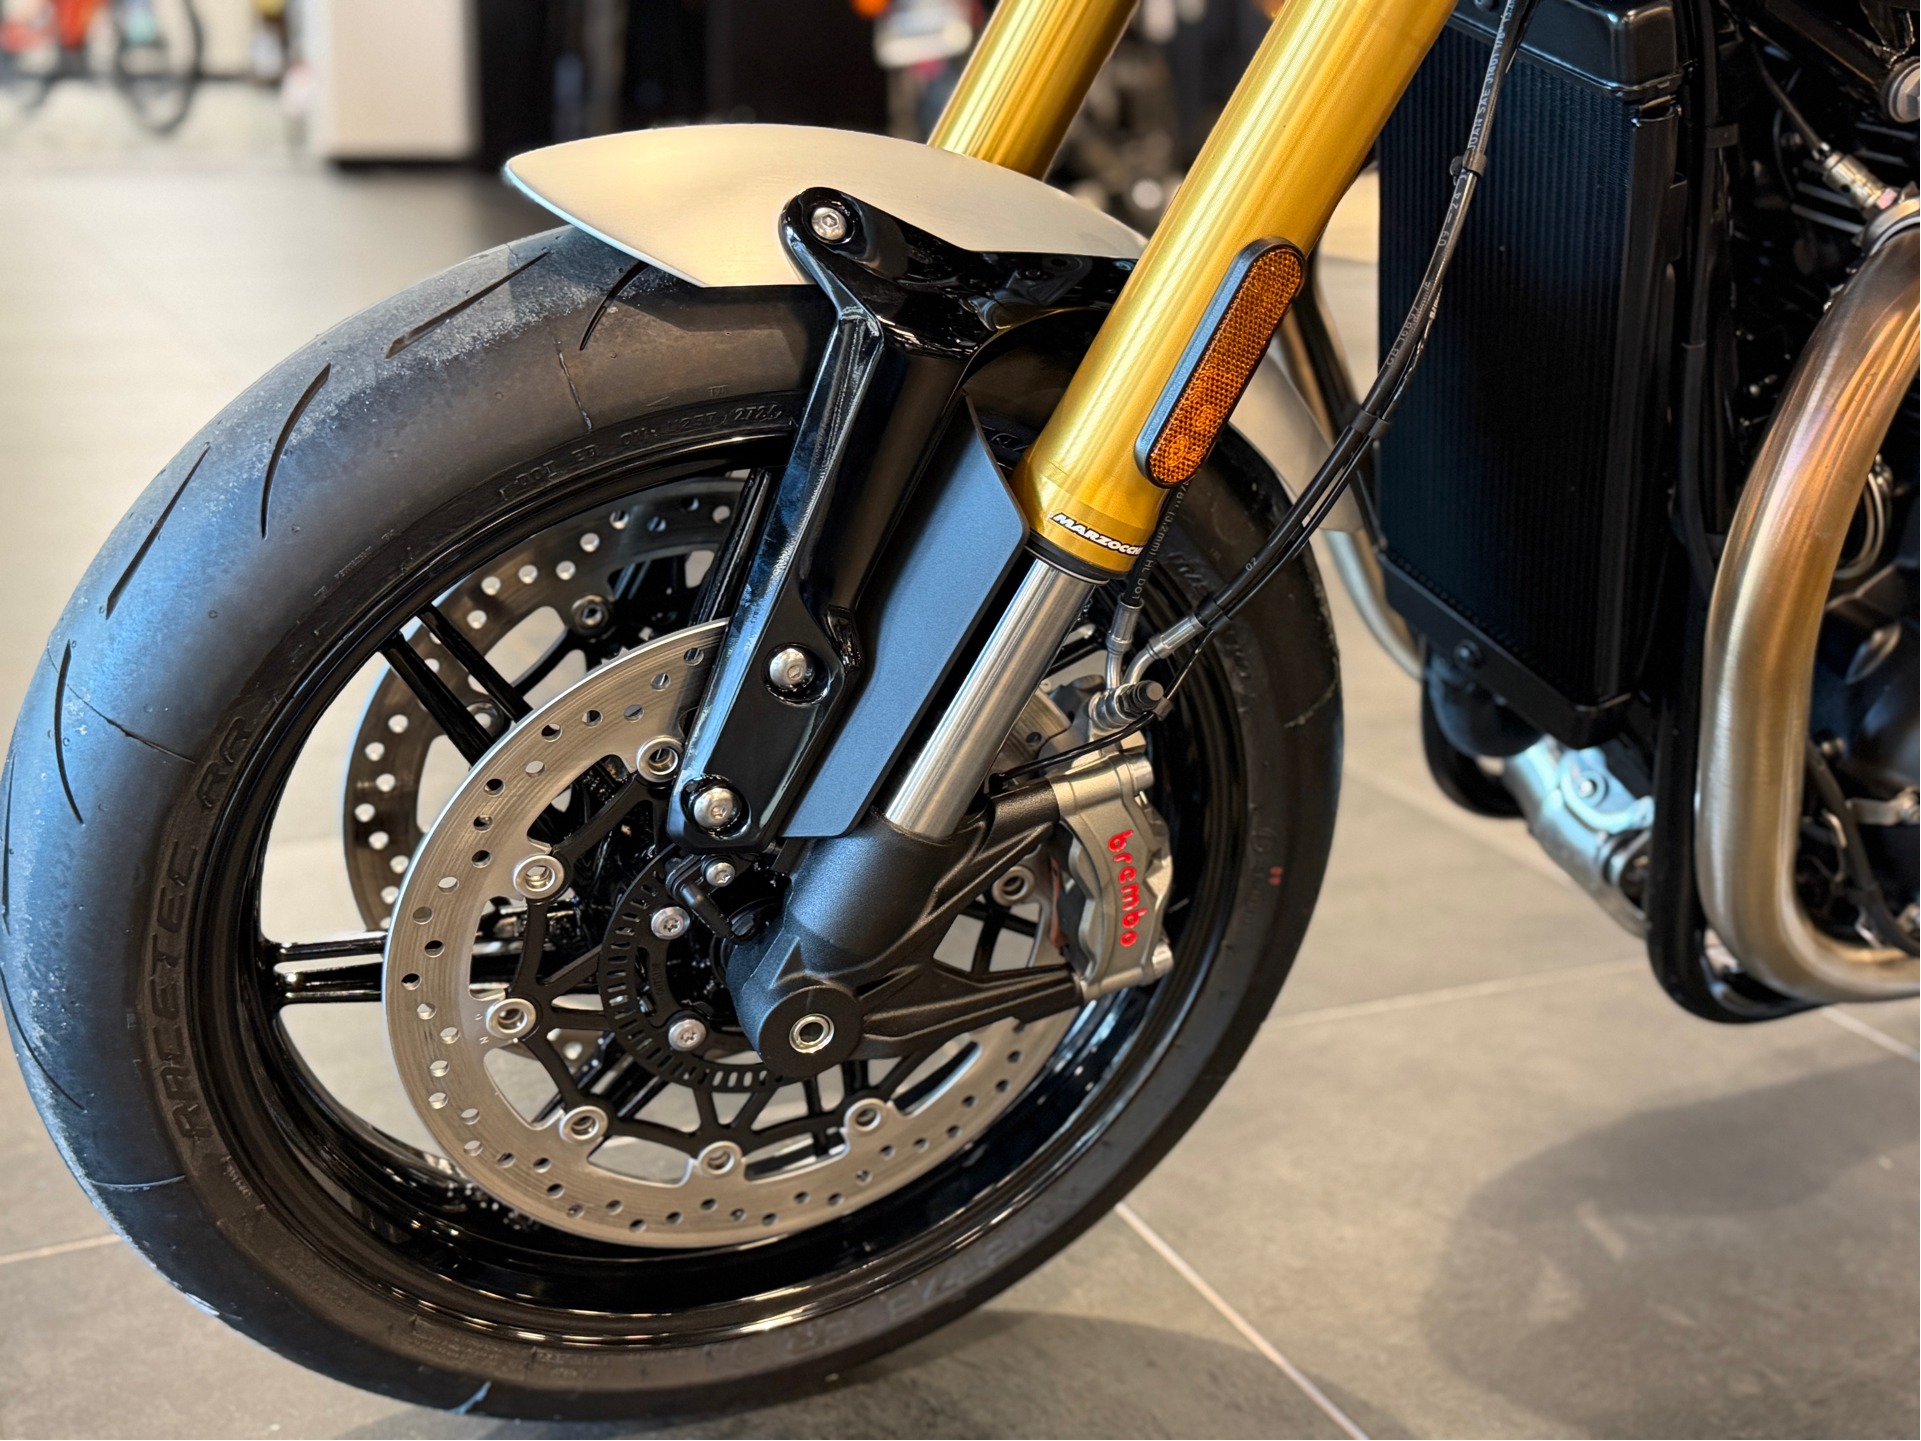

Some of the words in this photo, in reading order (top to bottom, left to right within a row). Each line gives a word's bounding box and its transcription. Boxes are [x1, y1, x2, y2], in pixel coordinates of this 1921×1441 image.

[1468, 118, 1482, 150] JUAN
[1480, 88, 1490, 113] SAE
[1386, 347, 1399, 366] GB
[1054, 512, 1144, 556] MARZOCCH
[1141, 559, 1152, 574] HL
[1245, 557, 1258, 571] 02
[1108, 829, 1148, 947] brembo
[151, 839, 212, 1145] RACETEC
[196, 715, 253, 809] RR
